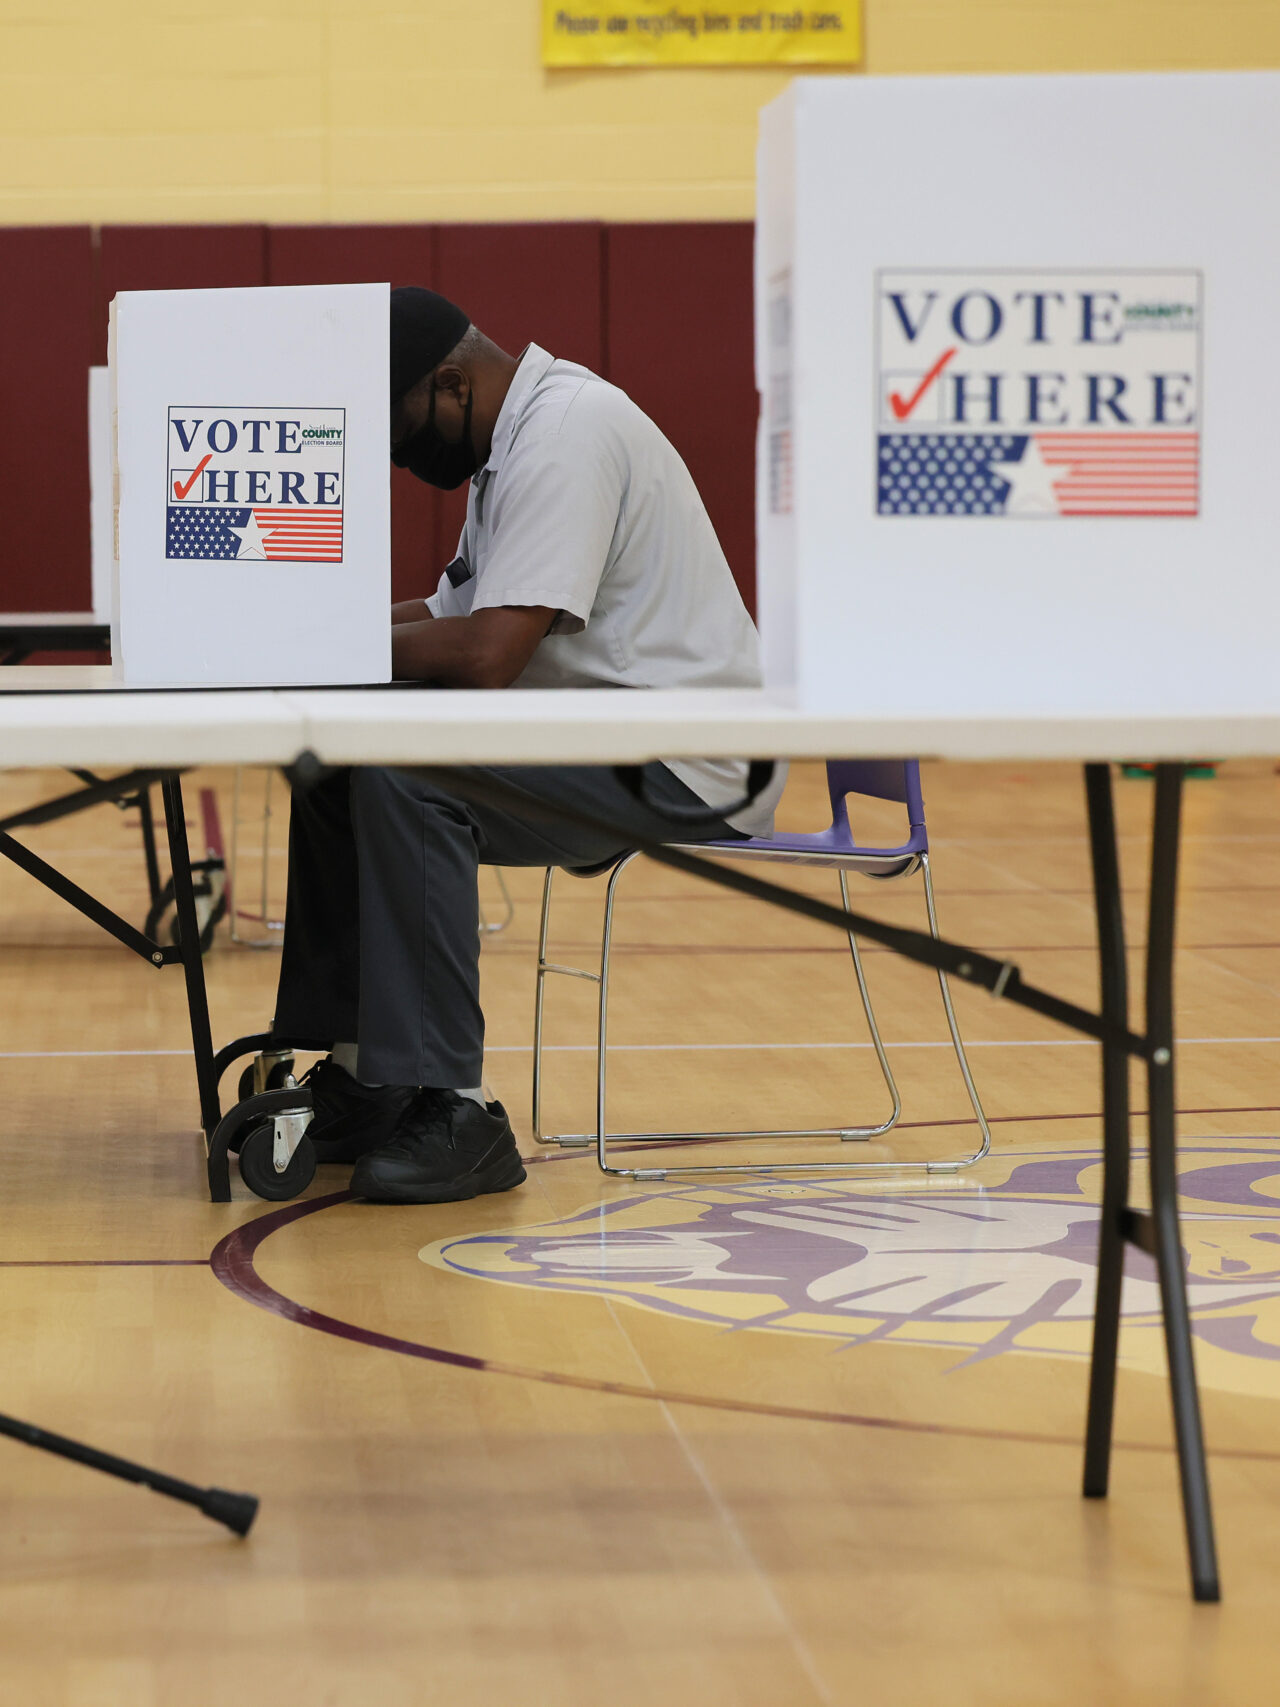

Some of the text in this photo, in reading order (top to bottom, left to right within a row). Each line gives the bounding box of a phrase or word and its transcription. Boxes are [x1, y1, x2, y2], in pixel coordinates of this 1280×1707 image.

[884, 289, 1122, 345] VOTE
[949, 372, 1197, 425] HERE
[170, 419, 302, 453] VOTE
[301, 429, 342, 438] COUNTY
[205, 470, 341, 505] HERE
